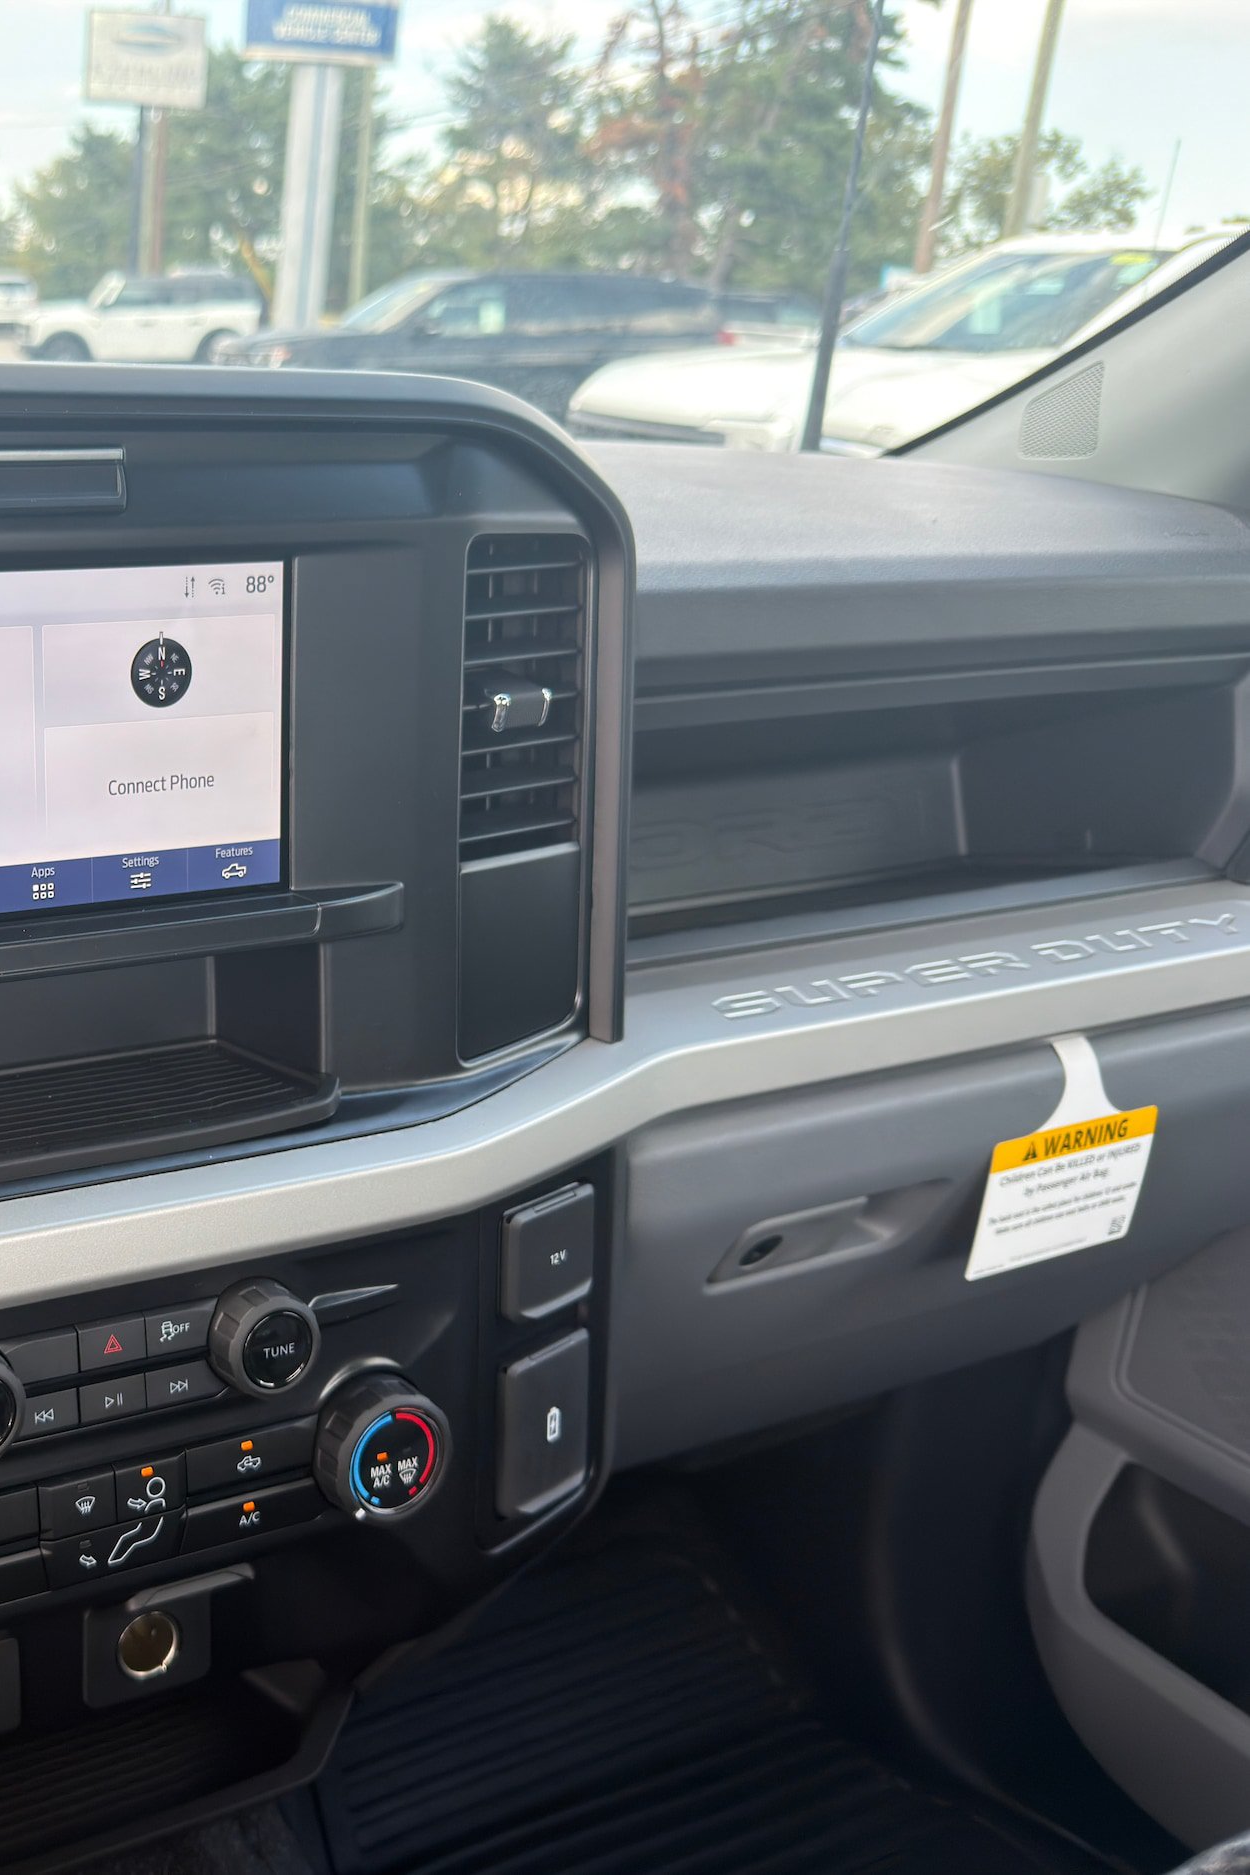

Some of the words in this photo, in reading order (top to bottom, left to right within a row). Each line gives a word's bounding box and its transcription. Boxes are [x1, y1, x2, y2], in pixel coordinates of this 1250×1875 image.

[158, 646, 166, 660] N
[138, 669, 151, 680] W
[173, 668, 185, 676] E
[158, 686, 166, 700] S
[107, 774, 168, 796] Connect
[170, 771, 215, 791] Phone
[214, 844, 254, 859] Features
[121, 853, 161, 870] Settings
[31, 864, 56, 881] Apps
[711, 950, 1031, 1020] SUPER
[1030, 912, 1239, 963] DUTY
[1043, 1118, 1129, 1157] WARNING
[172, 1322, 190, 1334] OFF
[263, 1341, 296, 1358] TUNE
[370, 1463, 392, 1478] MAX
[397, 1456, 418, 1472] MAX
[373, 1475, 390, 1489] A/C
[238, 1510, 261, 1527] A/C
